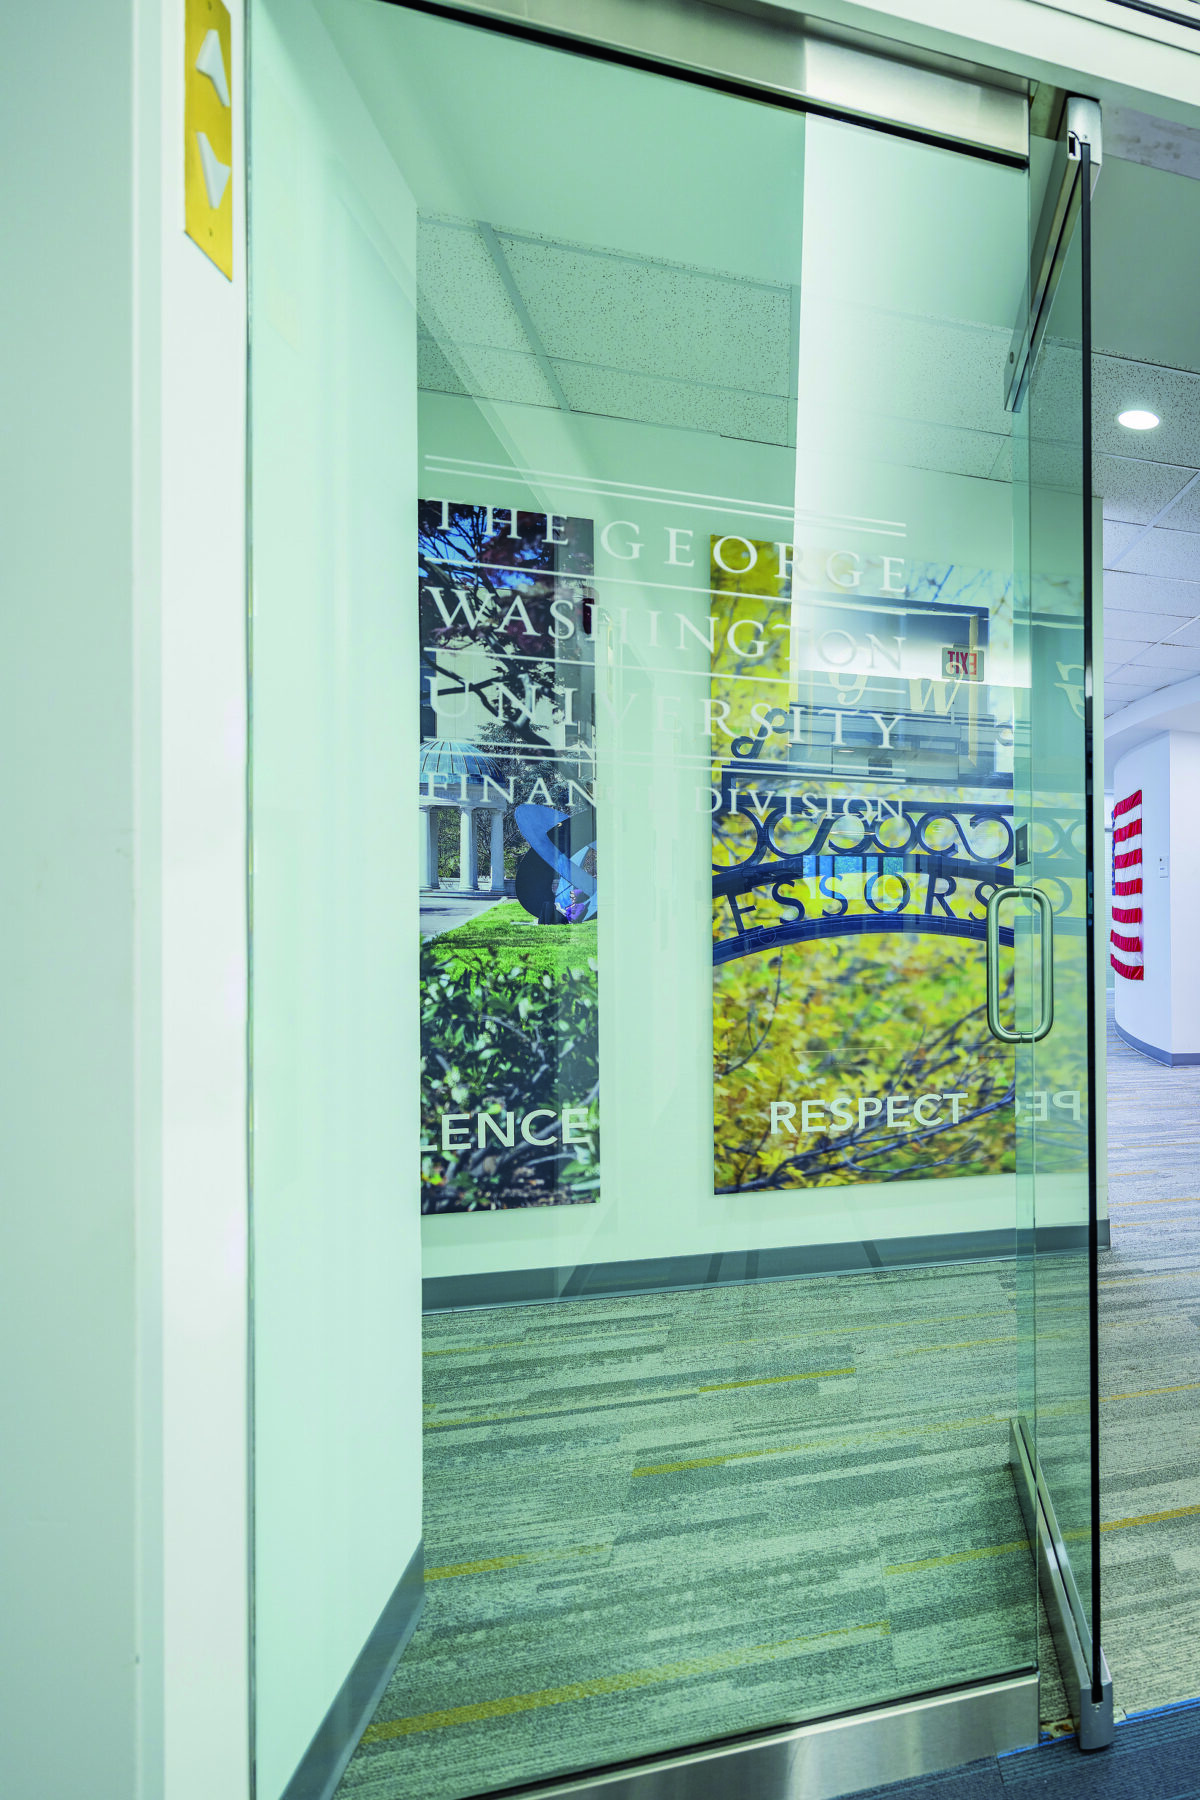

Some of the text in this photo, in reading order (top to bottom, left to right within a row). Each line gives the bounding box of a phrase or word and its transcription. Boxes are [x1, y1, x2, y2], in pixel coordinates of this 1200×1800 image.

[424, 496, 908, 595] THE GEORGE
[423, 584, 908, 674] WASHINGTON
[424, 674, 907, 750] UNIVERSITY
[695, 786, 904, 823] DIVISION
[769, 1092, 969, 1135] RESPECT
